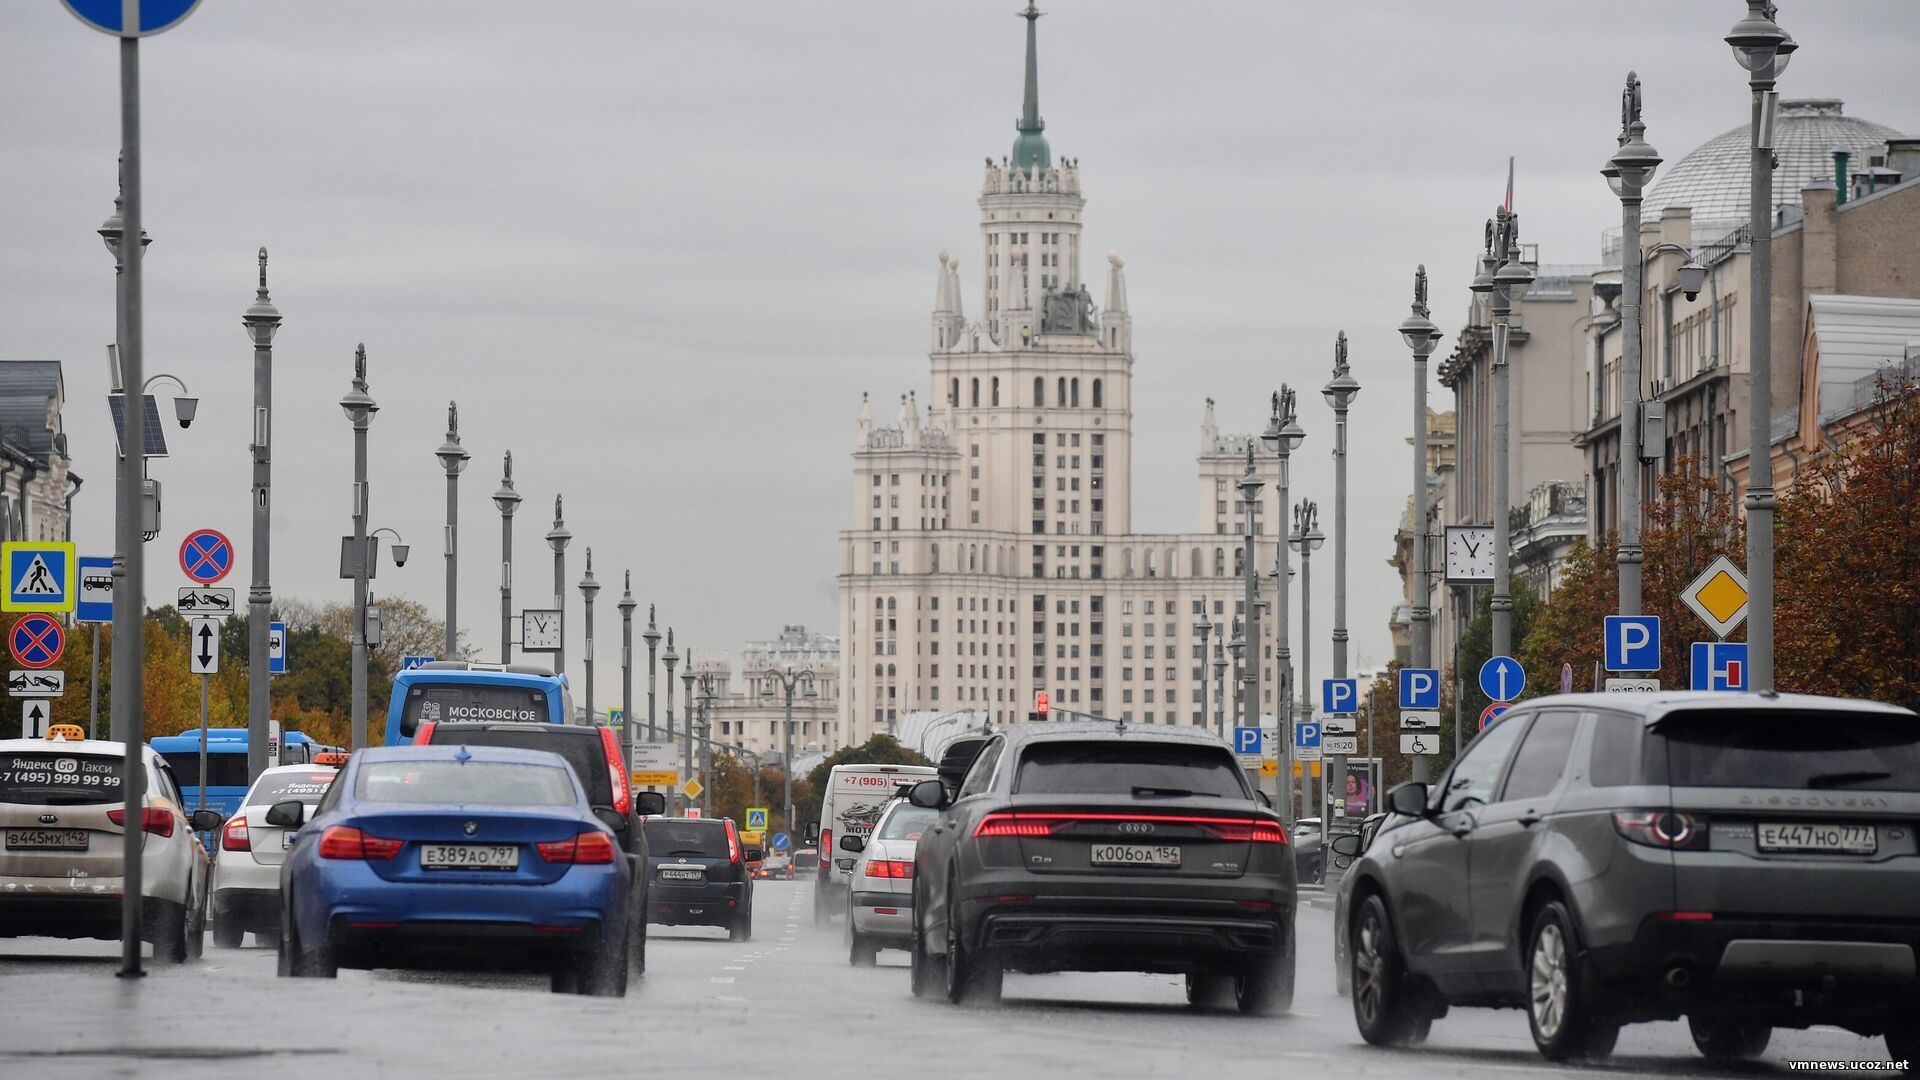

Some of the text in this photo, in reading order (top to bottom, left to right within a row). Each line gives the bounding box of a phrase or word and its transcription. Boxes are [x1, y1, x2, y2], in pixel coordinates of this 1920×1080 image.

[1620, 622, 1650, 665] P
[1332, 682, 1351, 710] P
[1410, 673, 1433, 704] P
[449, 706, 536, 721] МОСКОВСКОЕ
[1241, 730, 1258, 752] P
[1303, 725, 1317, 745] P
[1342, 741, 1354, 750] 20
[12, 758, 113, 774] Яндекс Go Такси
[14, 771, 52, 785] (495)
[54, 774, 80, 785] 999
[83, 775, 100, 786] 99
[103, 777, 121, 787] 99
[844, 776, 858, 785] +7
[859, 777, 887, 788] (905)
[65, 832, 84, 843] 142
[1766, 827, 1839, 846] Е447НО
[1841, 827, 1869, 842] 777
[427, 847, 513, 863] Е389АО 797
[1096, 846, 1178, 862] К006ОА 154
